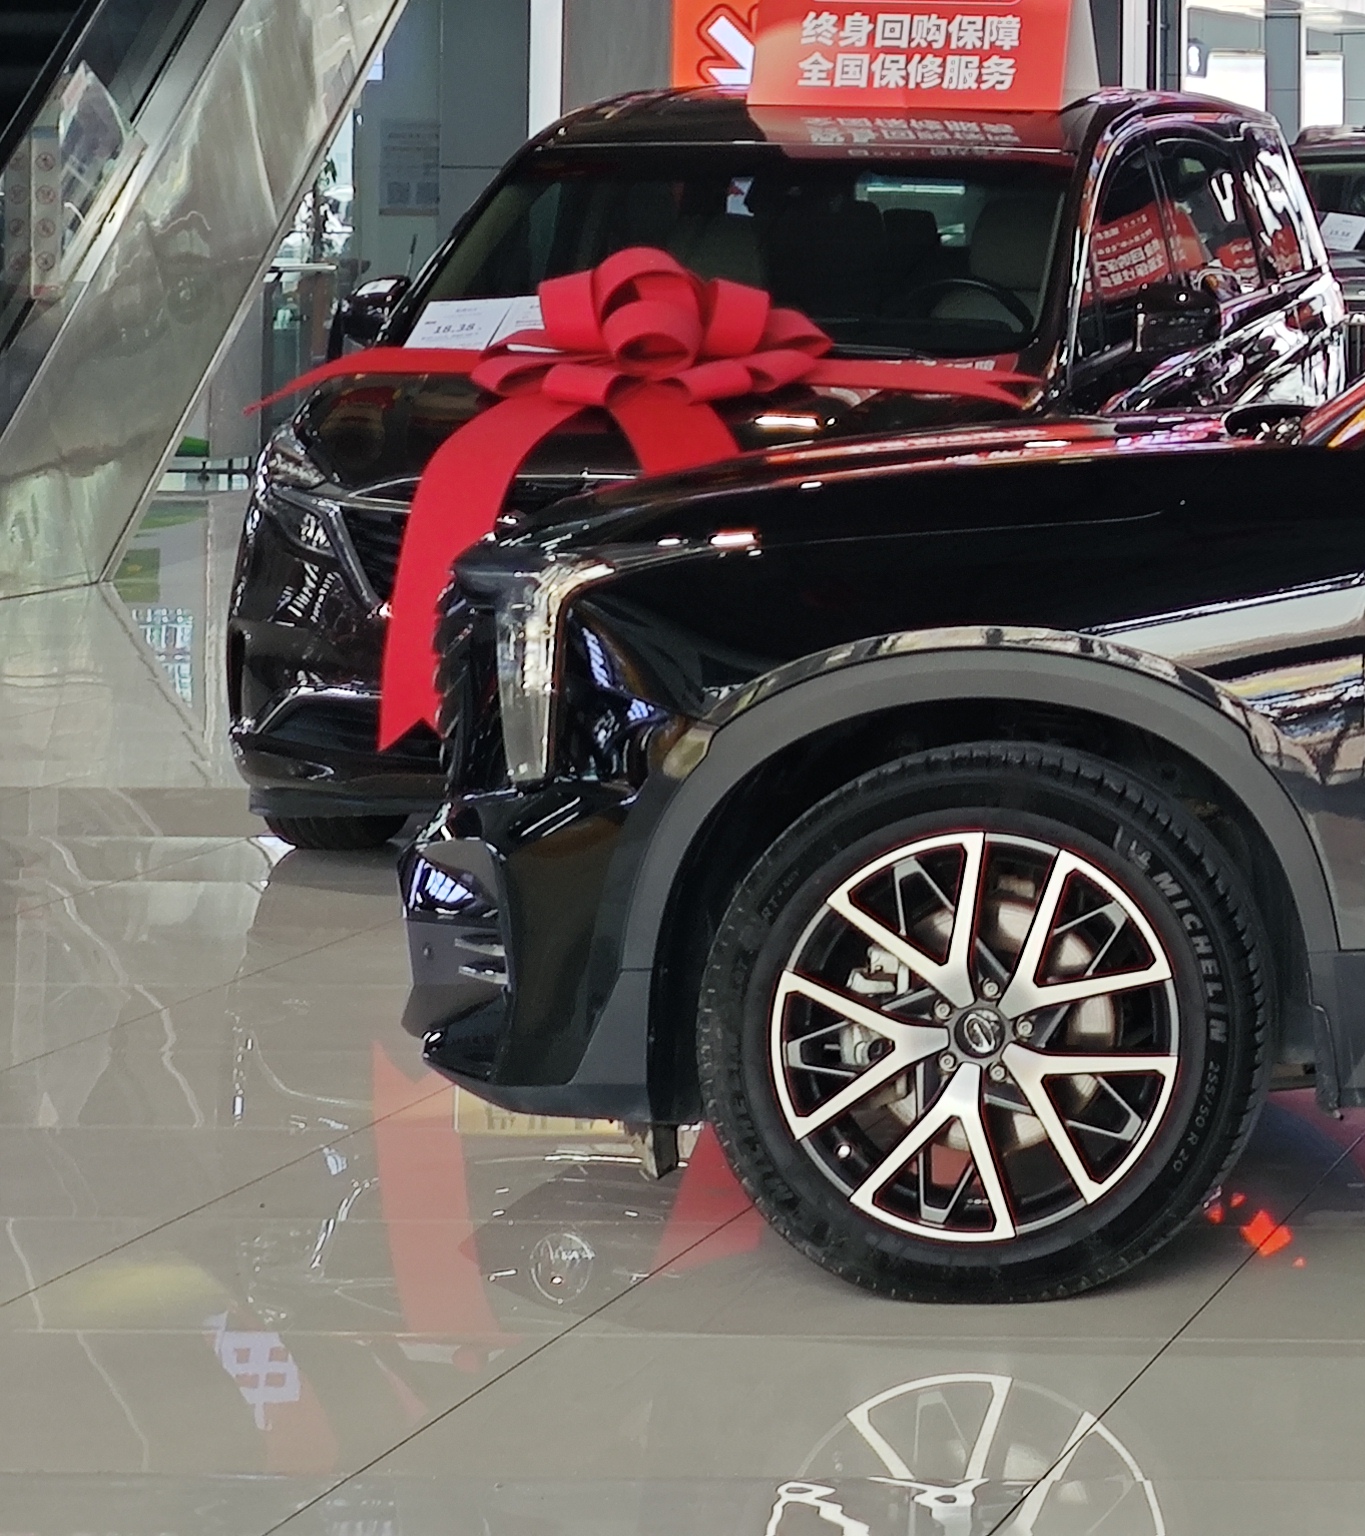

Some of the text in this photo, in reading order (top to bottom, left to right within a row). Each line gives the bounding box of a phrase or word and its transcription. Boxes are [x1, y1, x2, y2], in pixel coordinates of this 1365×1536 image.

[801, 11, 1022, 52] 终身回购保障
[797, 52, 1017, 92] 全国保修服务
[1152, 869, 1229, 1045] MICHELIN
[1194, 1060, 1222, 1130] 255/50
